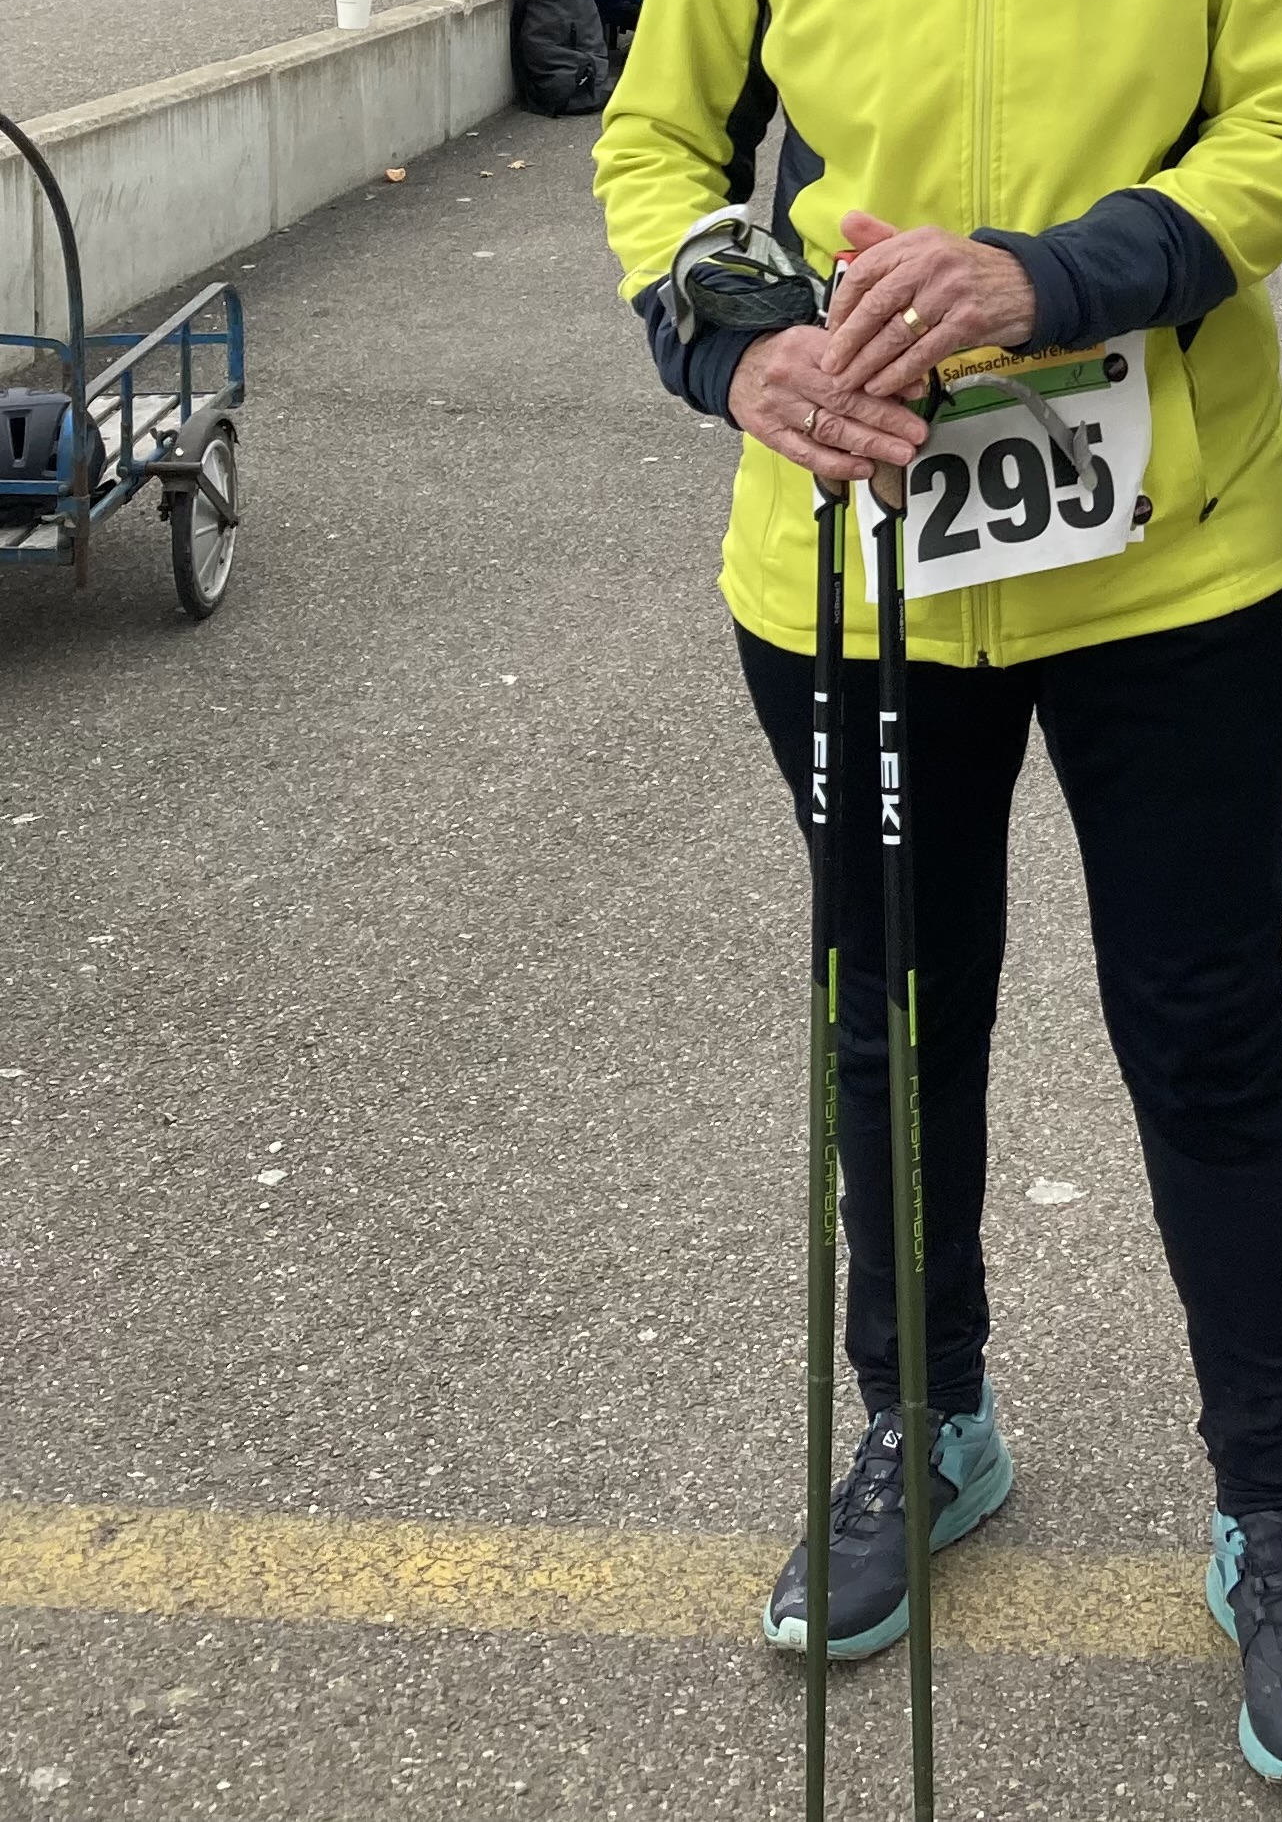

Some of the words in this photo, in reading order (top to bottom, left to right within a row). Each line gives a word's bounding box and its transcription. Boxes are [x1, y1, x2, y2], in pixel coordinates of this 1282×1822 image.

[910, 422, 1115, 563] 295
[812, 691, 828, 824] LEKI
[879, 711, 901, 845] LEKI
[825, 1052, 836, 1137] FLASH
[909, 1075, 921, 1162] FLASH
[824, 1144, 836, 1246] CARBON
[912, 1168, 924, 1273] CARBON
